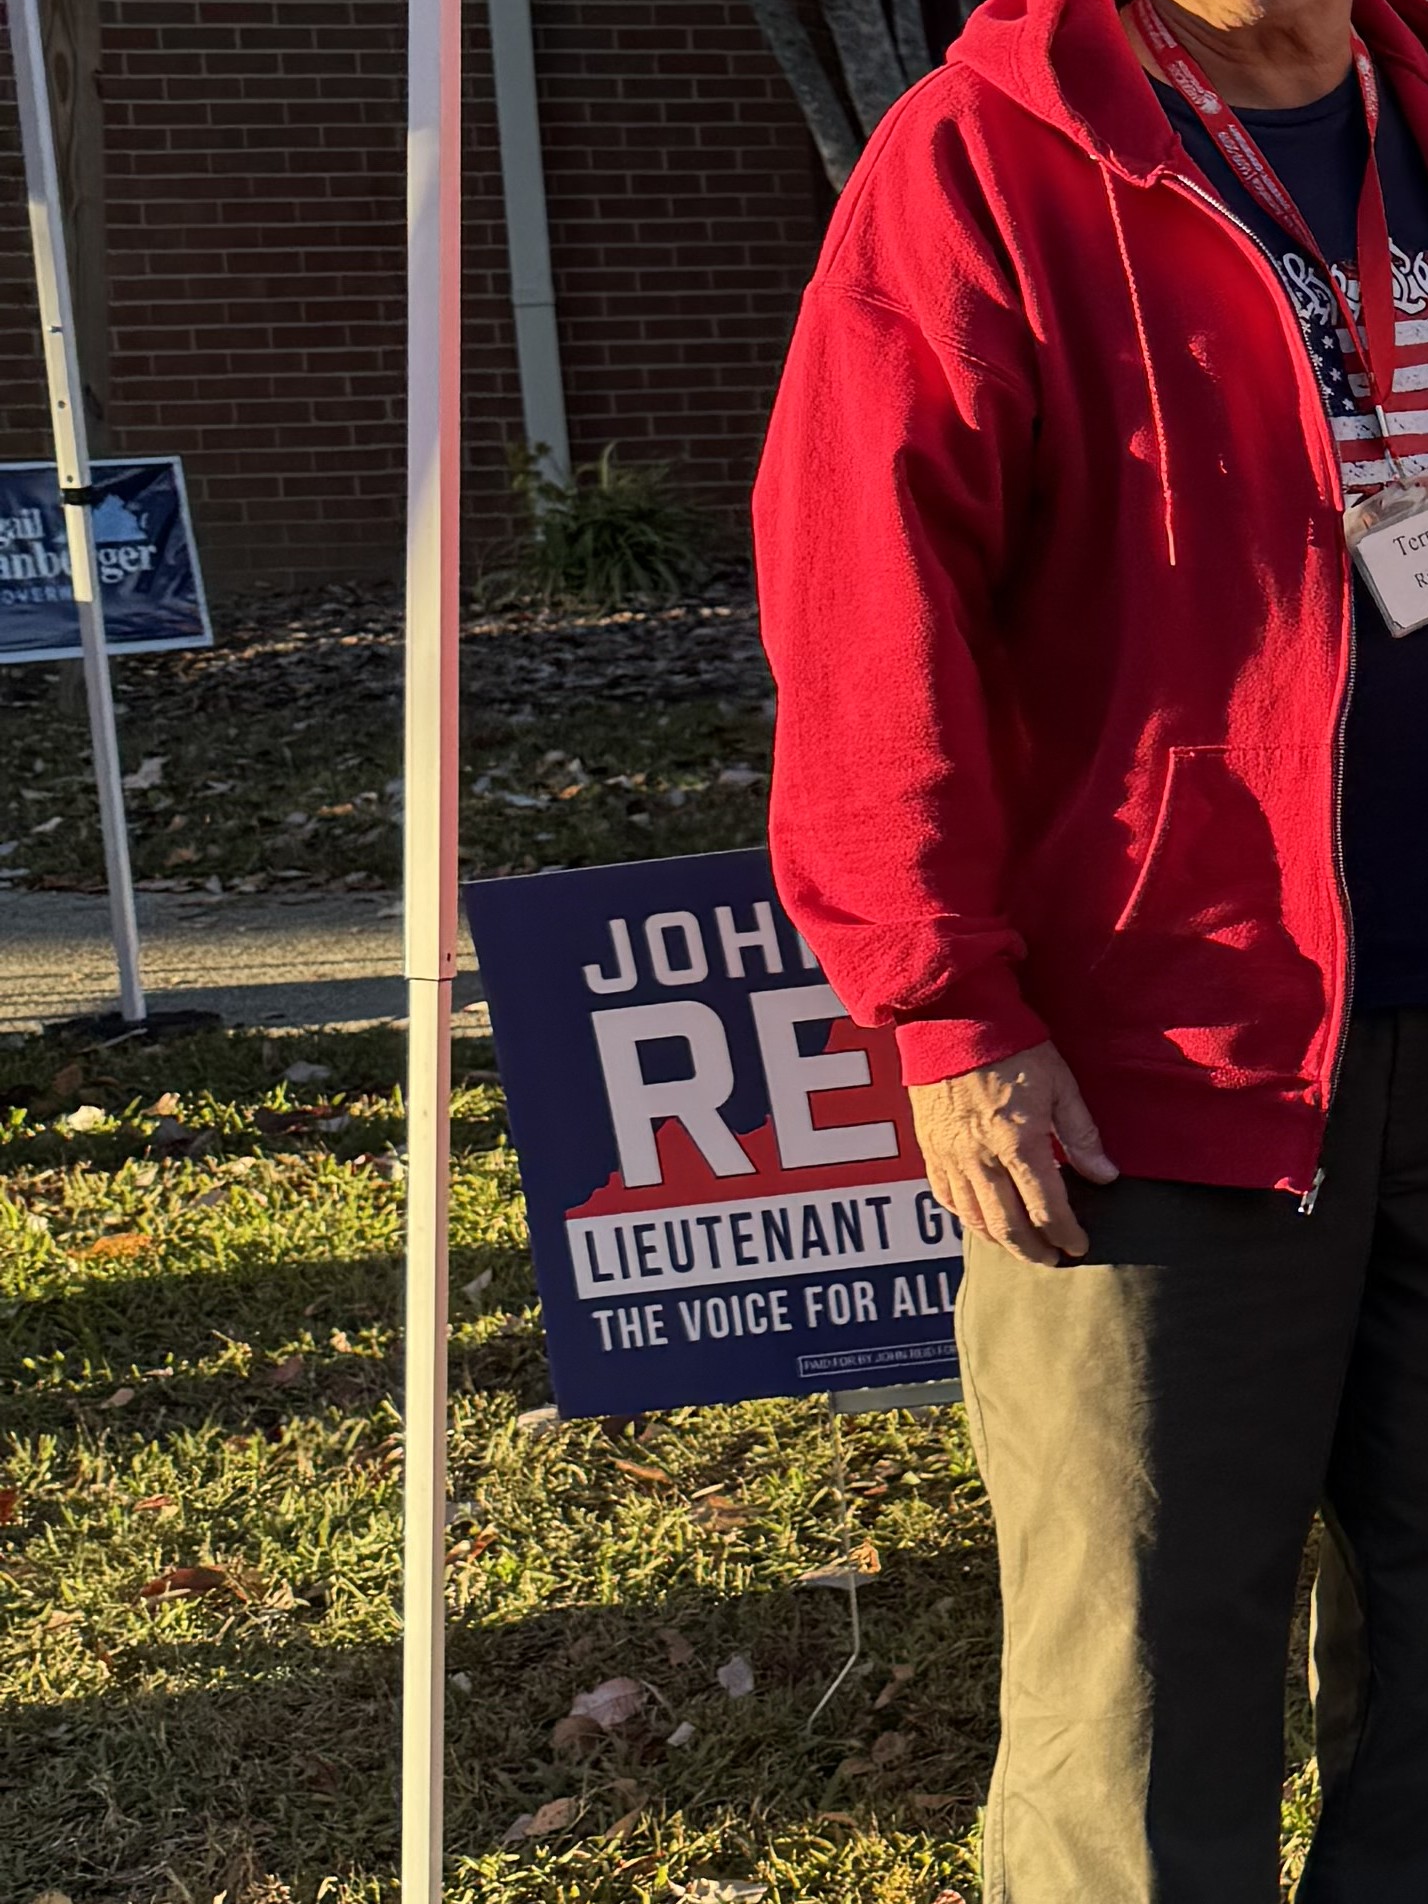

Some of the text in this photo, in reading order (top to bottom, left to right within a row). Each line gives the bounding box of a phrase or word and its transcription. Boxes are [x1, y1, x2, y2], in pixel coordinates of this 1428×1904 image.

[591, 983, 899, 1189] RE
[584, 1197, 893, 1288] LIEUTENANT
[594, 1303, 669, 1352] THE
[680, 1289, 793, 1344] VOICE
[806, 1280, 879, 1330] FOR
